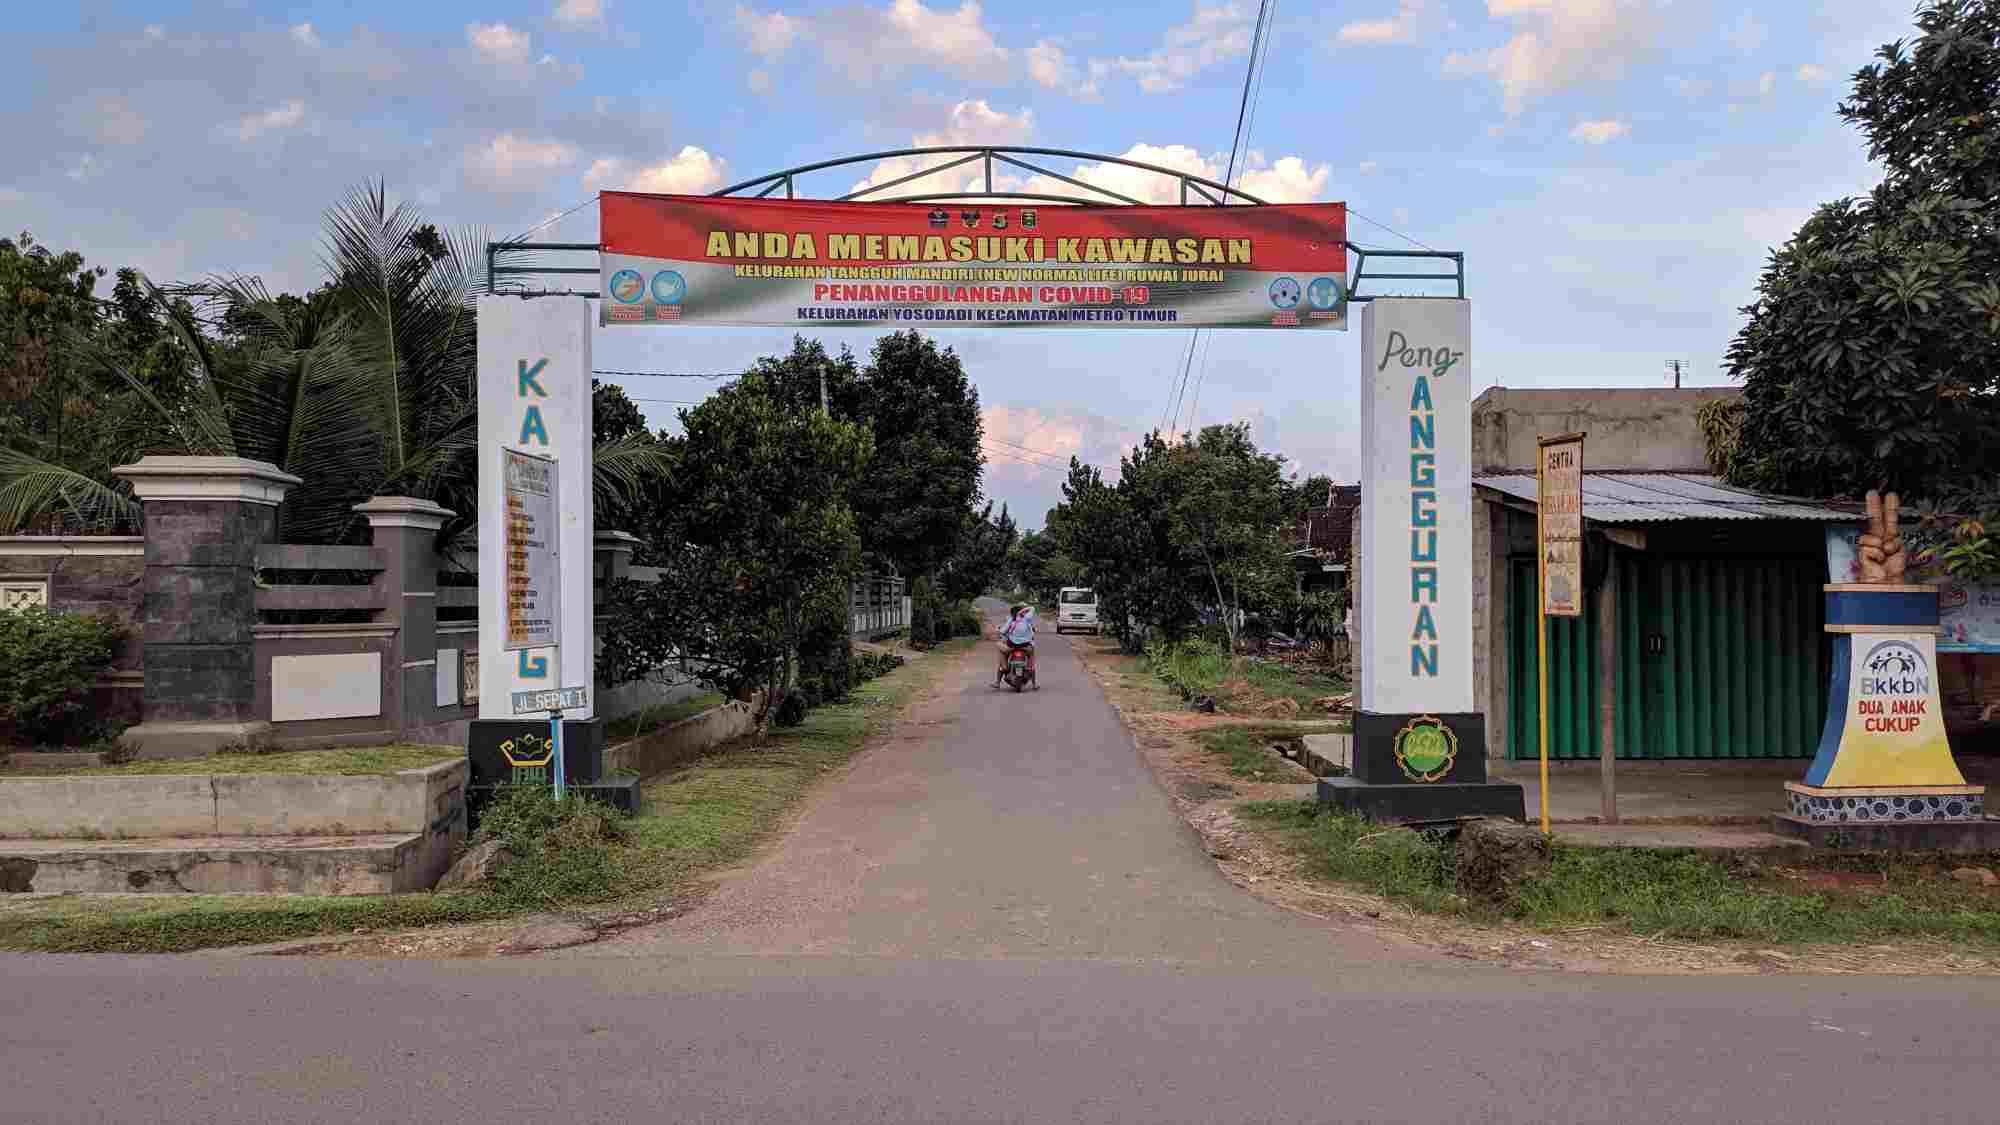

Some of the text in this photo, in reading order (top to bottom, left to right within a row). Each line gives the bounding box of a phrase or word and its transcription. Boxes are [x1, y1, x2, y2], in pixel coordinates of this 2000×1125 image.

[706, 231, 1252, 263] ANDA MEMASUKI KAWASAN
[735, 264, 826, 279] KELURAHAN
[830, 266, 903, 280] TANGGUH
[1022, 268, 1085, 281] NORMAL
[814, 283, 1150, 305] PENANGGULANGAN COVID-19
[797, 307, 1178, 322] KELURAHAN YOSODADI KECAMATAN METRO TIMUR
[1409, 375, 1439, 677] ANGGURAN
[1858, 700, 1927, 715] DUA ANAK
[1865, 717, 1921, 732] CUKUP
